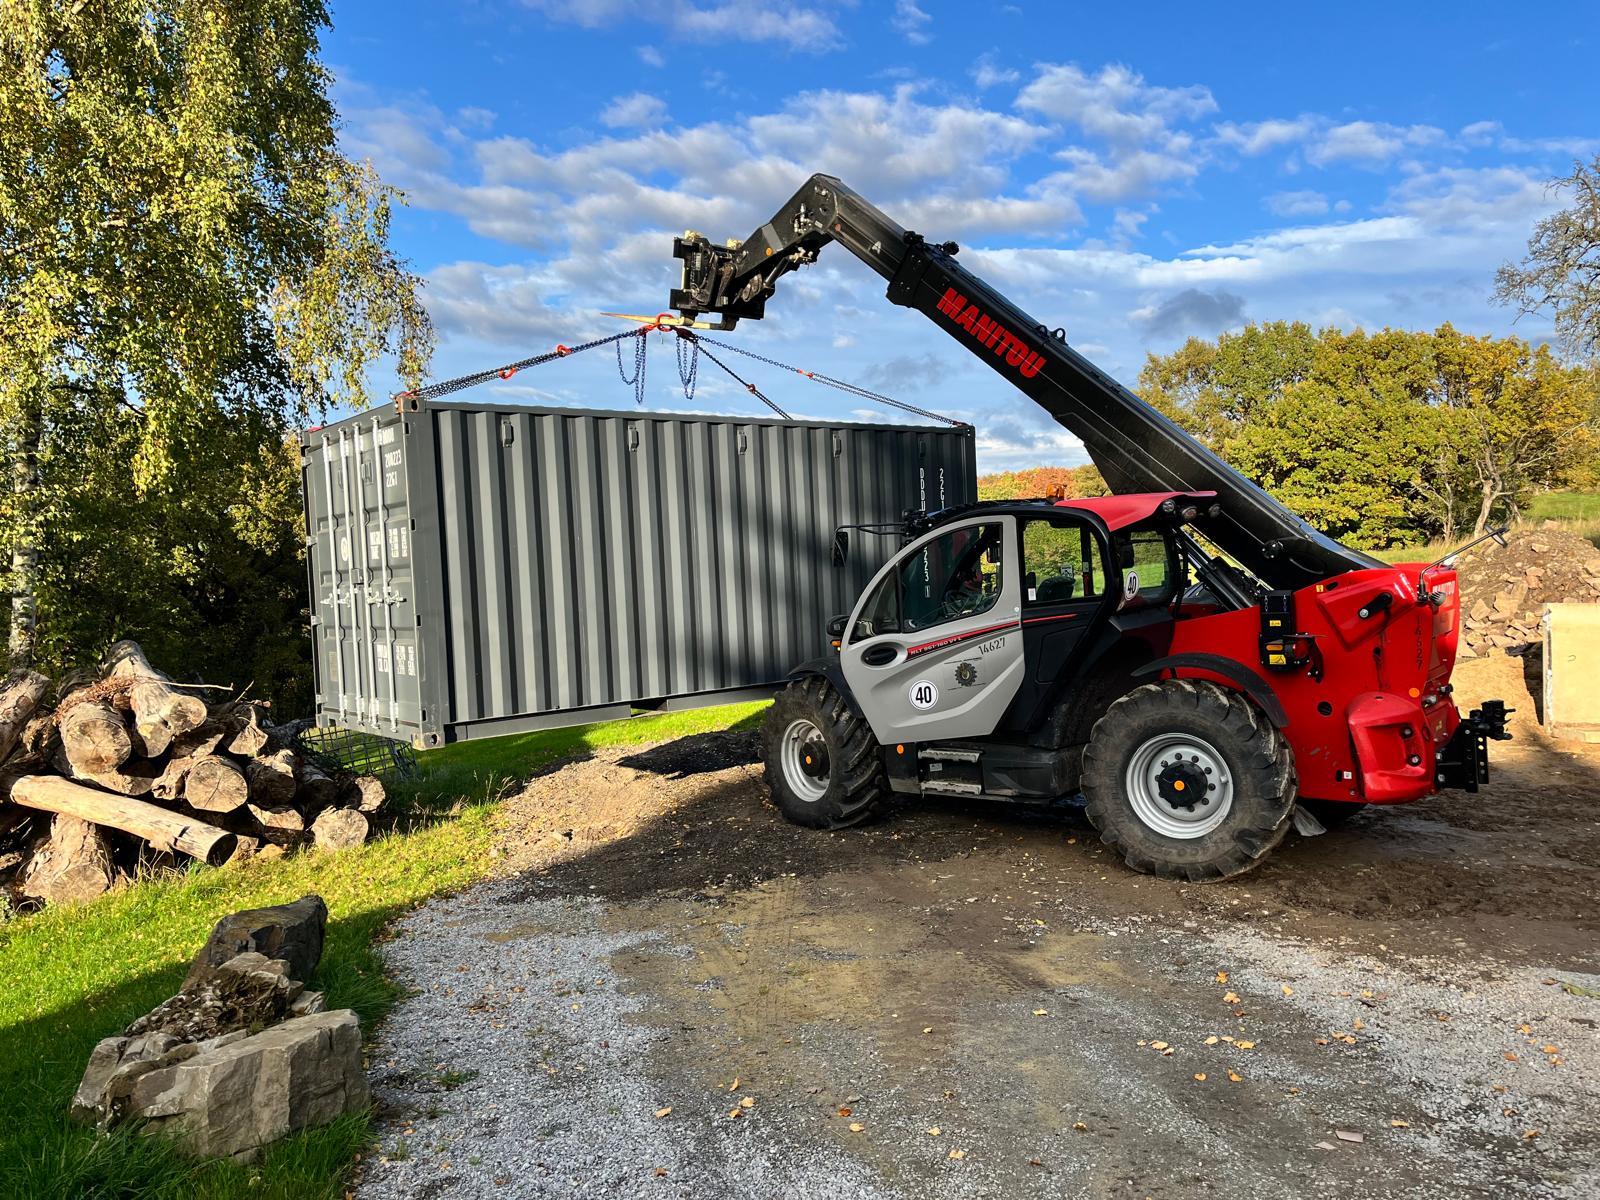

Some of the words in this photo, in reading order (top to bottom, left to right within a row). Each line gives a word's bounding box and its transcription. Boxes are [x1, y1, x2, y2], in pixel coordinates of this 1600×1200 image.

[936, 287, 1047, 378] MANITOU
[1127, 576, 1137, 594] 40
[978, 638, 1006, 655] 14627
[915, 686, 932, 704] 40
